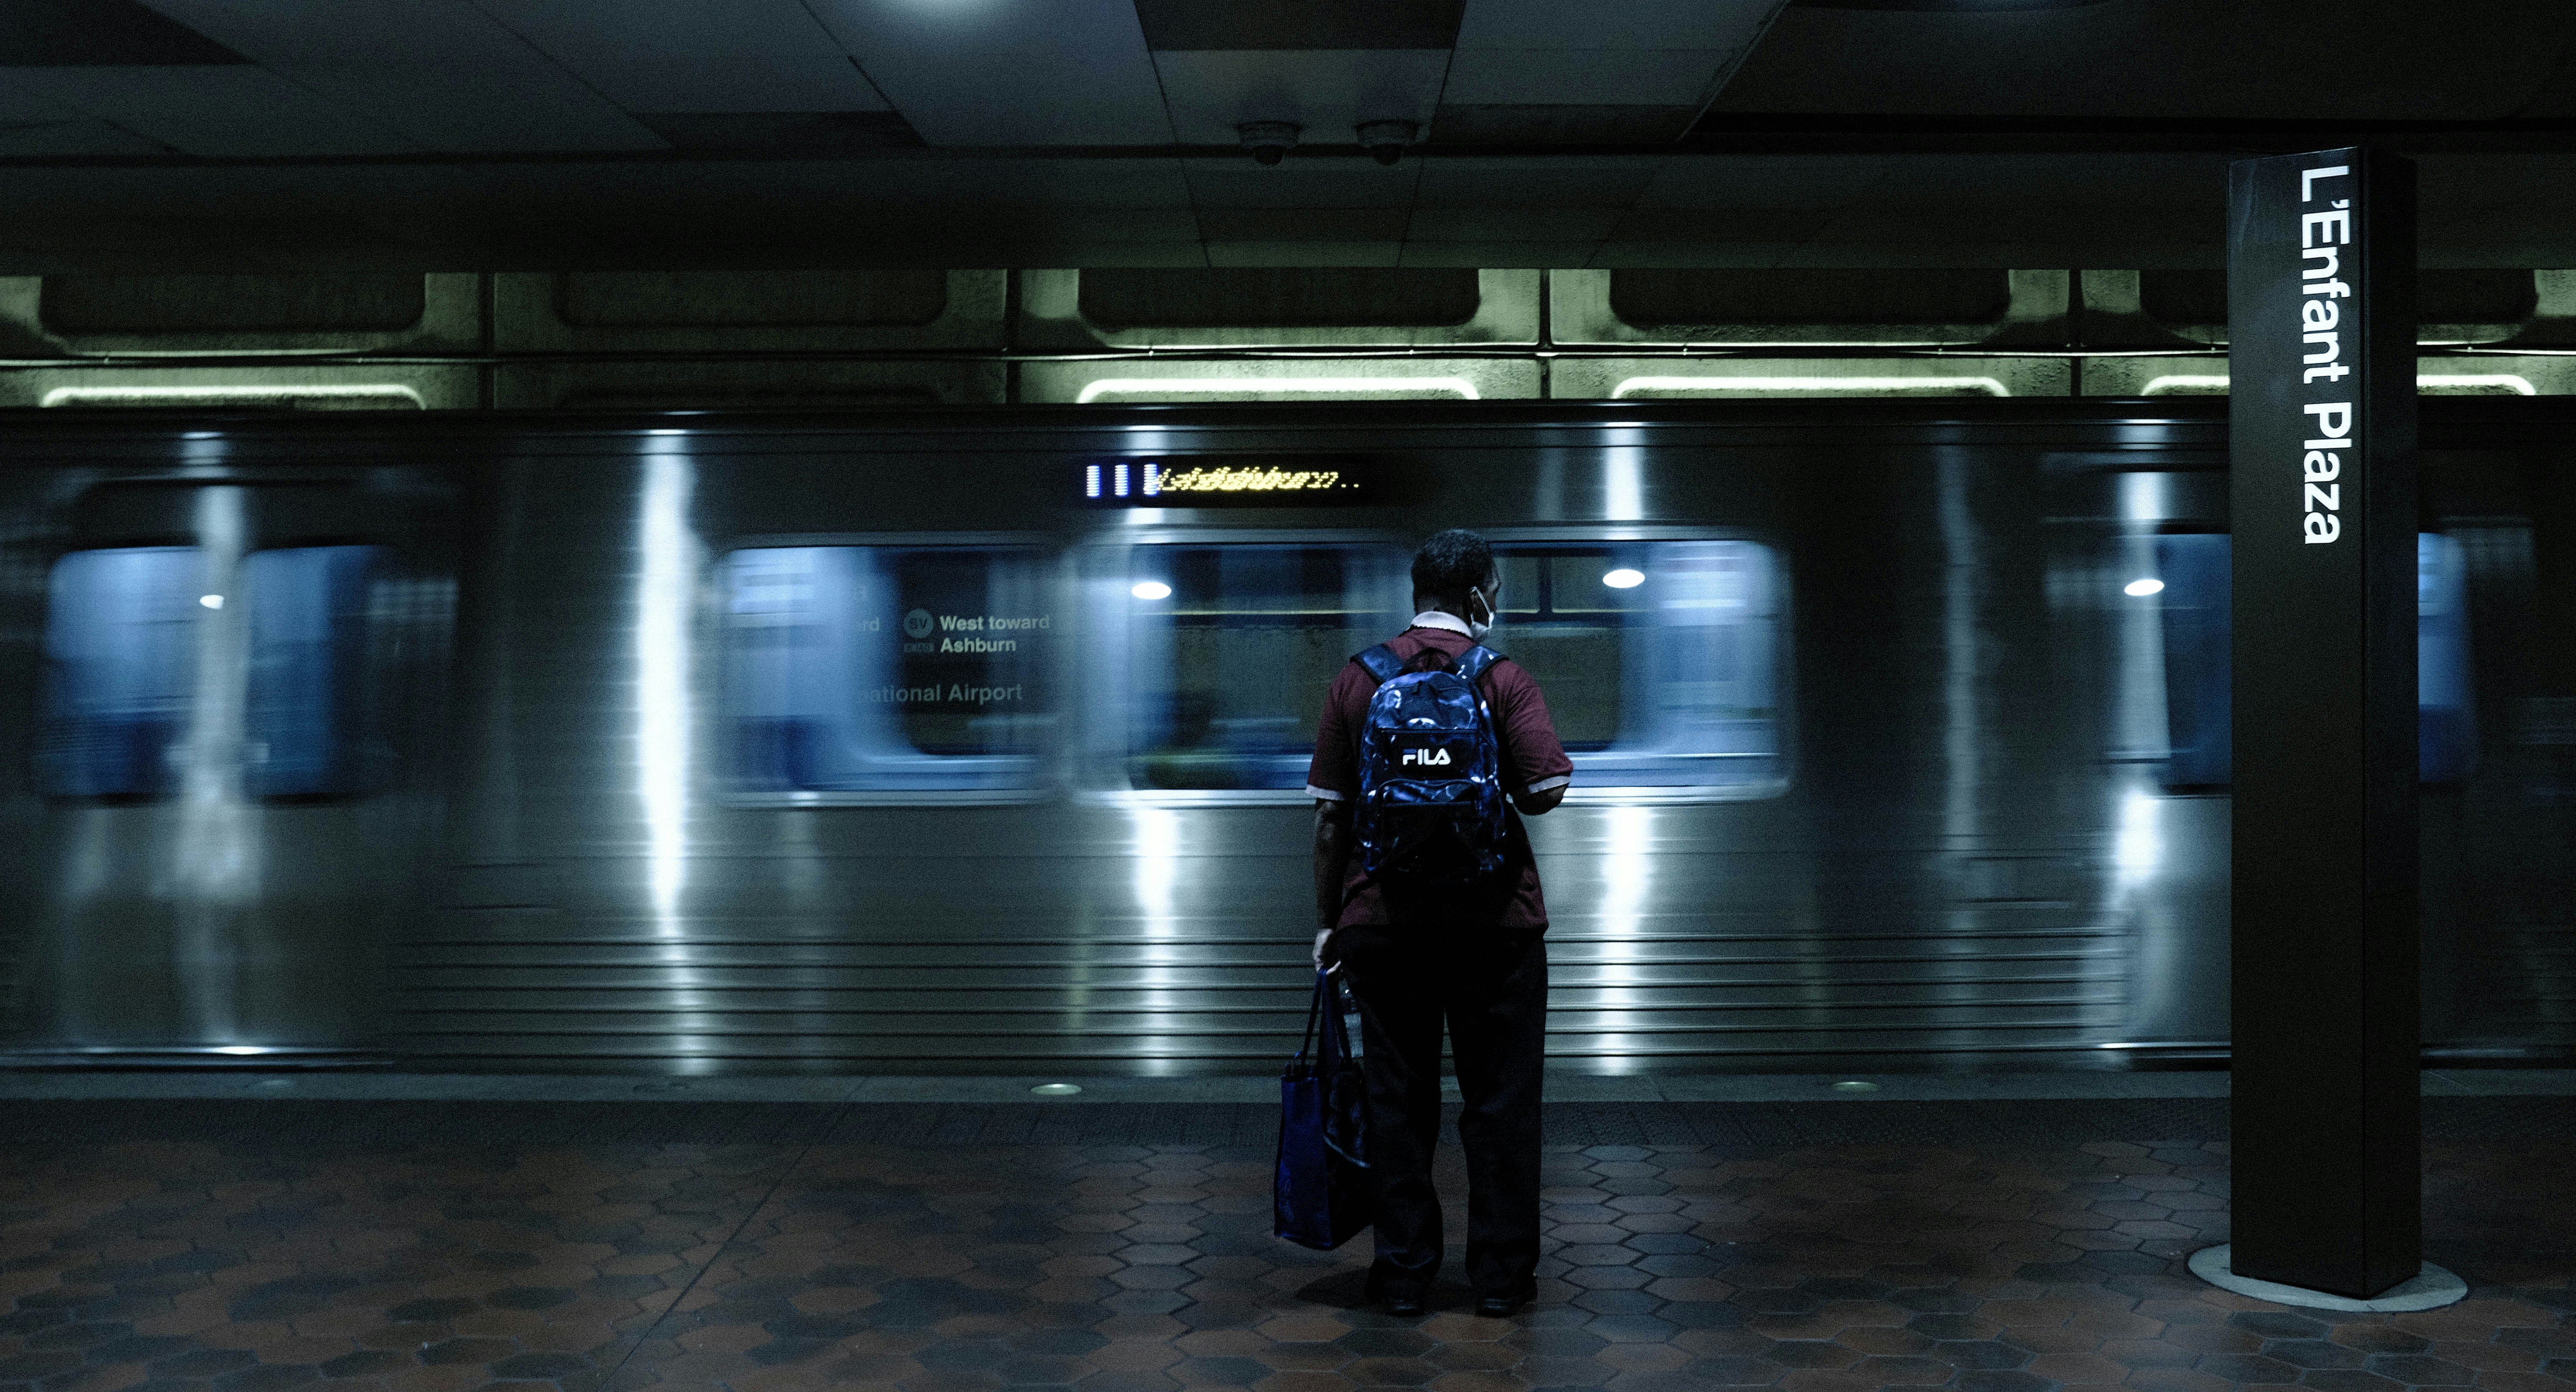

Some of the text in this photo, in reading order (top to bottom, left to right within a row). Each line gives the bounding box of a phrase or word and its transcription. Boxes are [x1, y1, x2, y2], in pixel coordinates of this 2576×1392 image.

[2302, 166, 2352, 544] L'Enfant Plaza
[939, 615, 1051, 631] West toward
[940, 637, 1017, 653] Ashburn
[949, 684, 1023, 705] Airport
[1402, 748, 1452, 766] FILA
